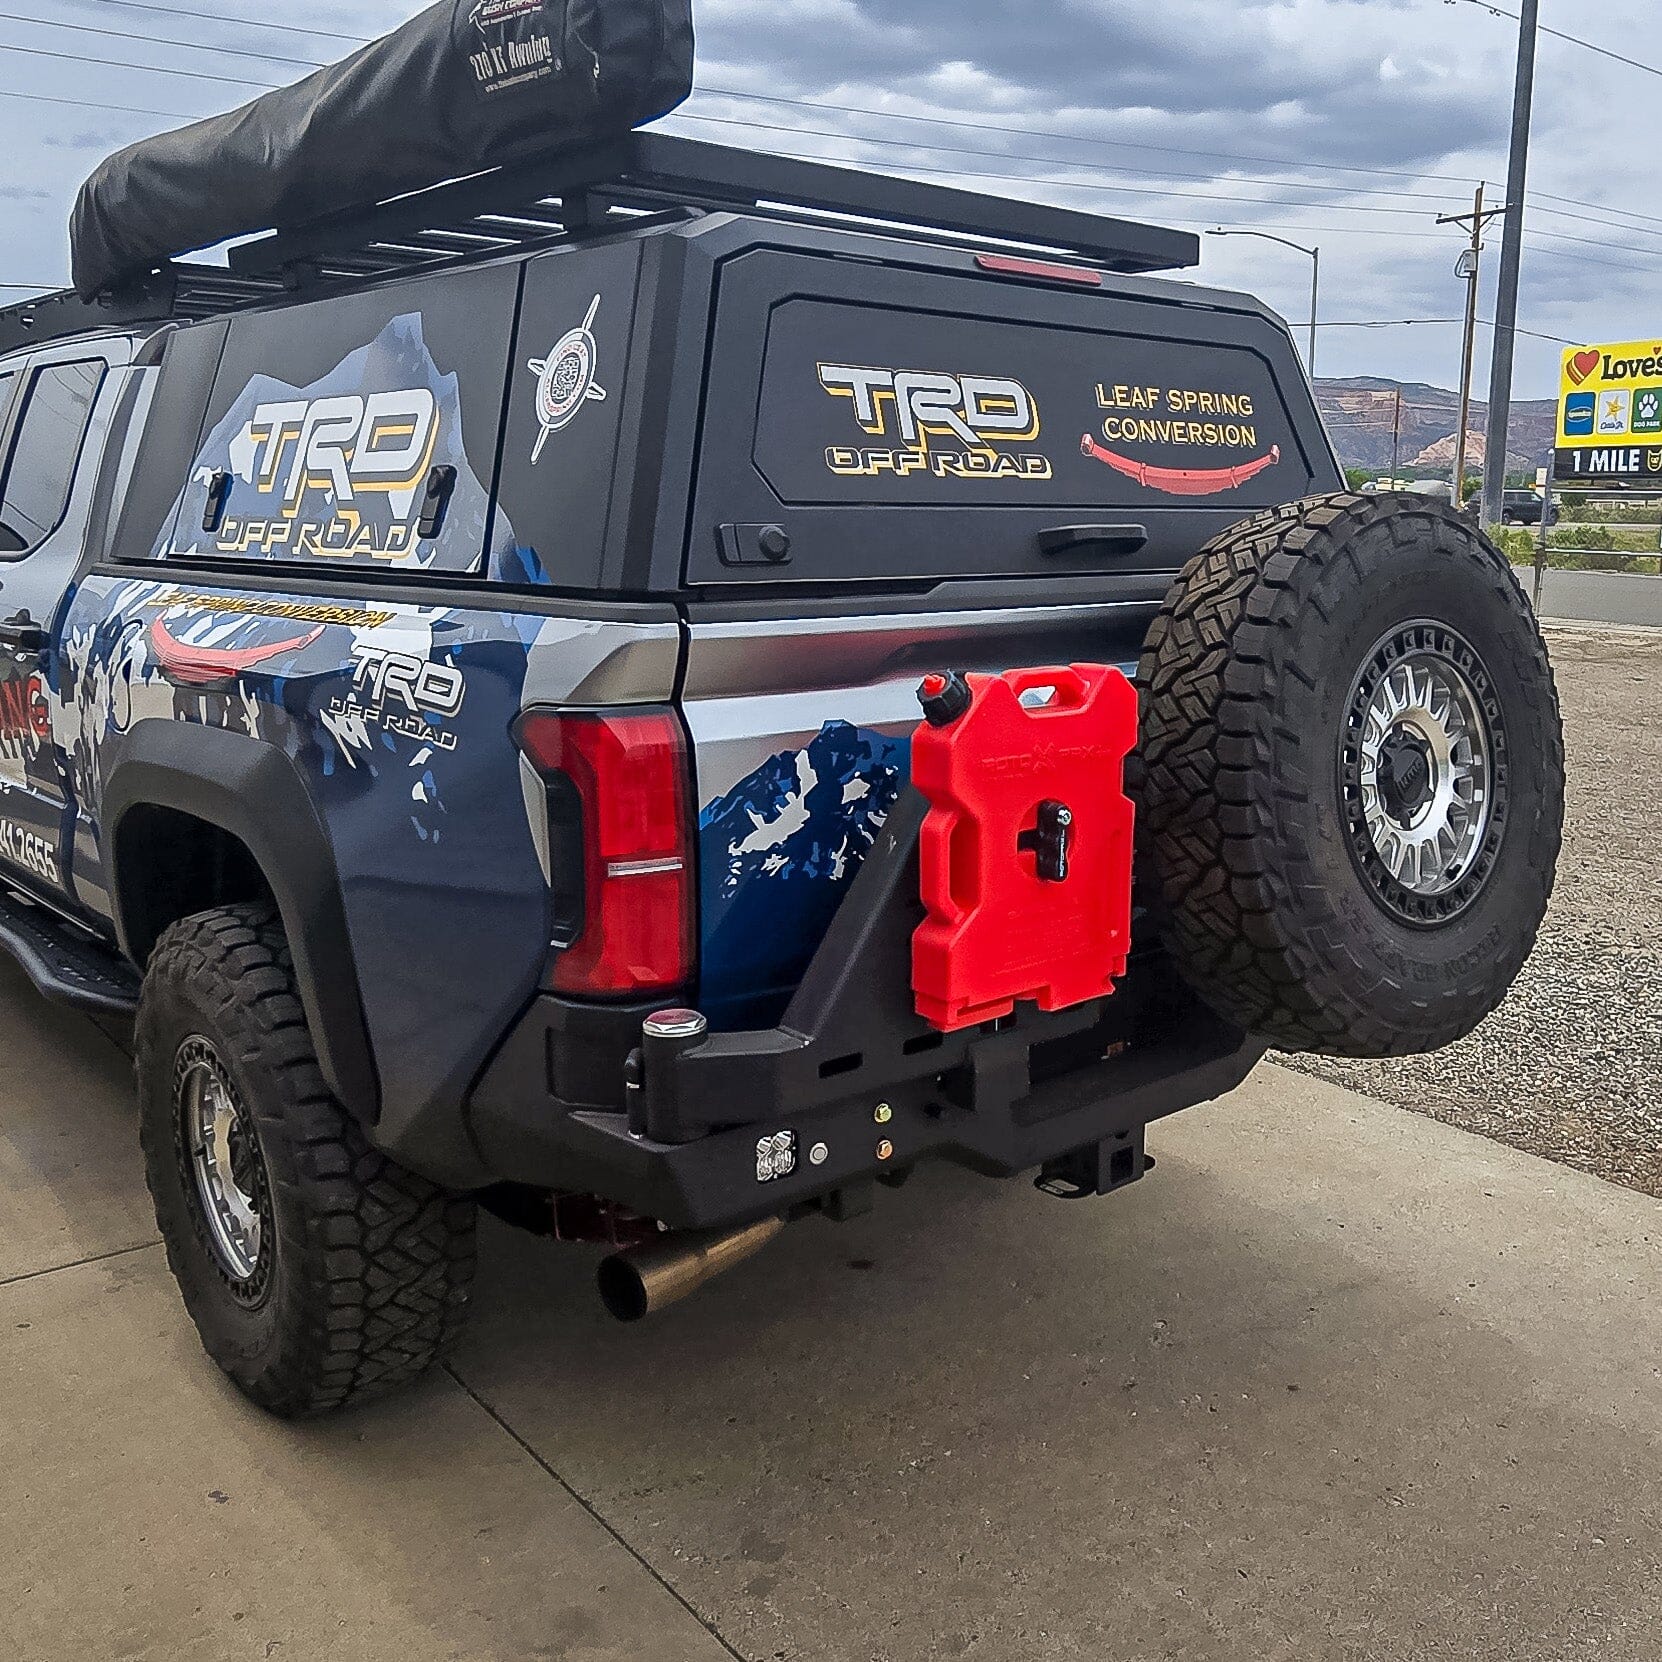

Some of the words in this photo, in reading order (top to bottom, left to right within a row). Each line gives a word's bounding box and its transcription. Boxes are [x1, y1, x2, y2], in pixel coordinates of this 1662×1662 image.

[469, 51, 493, 80] 270
[508, 34, 552, 69] Awning
[816, 362, 1040, 454] TRD
[1095, 383, 1160, 411] LEAF
[1166, 389, 1254, 417] SPRING
[250, 388, 440, 518] TRD
[1102, 417, 1257, 449] CONVERSION
[824, 447, 928, 477] OFF
[929, 450, 1053, 480] ROAD
[1572, 450, 1581, 472] 1
[1588, 449, 1640, 472] MILE
[216, 515, 291, 552] OFF
[292, 517, 419, 560] ROAD
[243, 599, 398, 629] CONVERSION
[348, 645, 466, 718] TRD
[328, 696, 379, 722] OFF
[383, 714, 457, 750] ROAD
